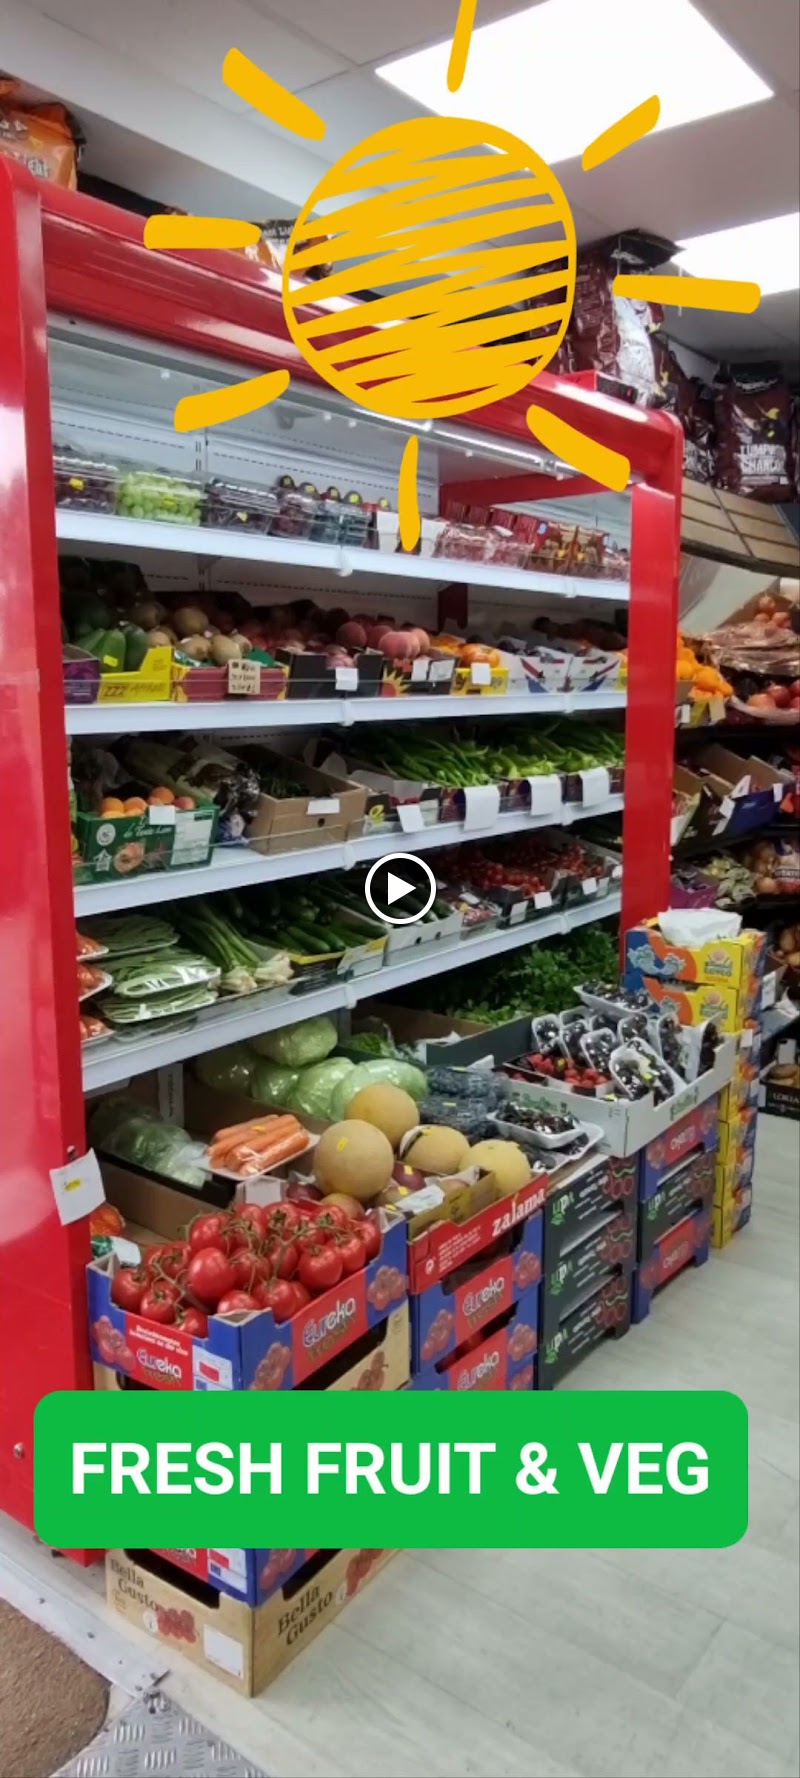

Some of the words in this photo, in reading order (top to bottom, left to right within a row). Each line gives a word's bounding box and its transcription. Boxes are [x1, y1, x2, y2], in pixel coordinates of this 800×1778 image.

[492, 1189, 546, 1237] zalama
[110, 1559, 144, 1589] Bella
[118, 1578, 160, 1612] Gusto
[278, 1586, 320, 1636] Bella
[286, 1591, 333, 1645] Gusto
